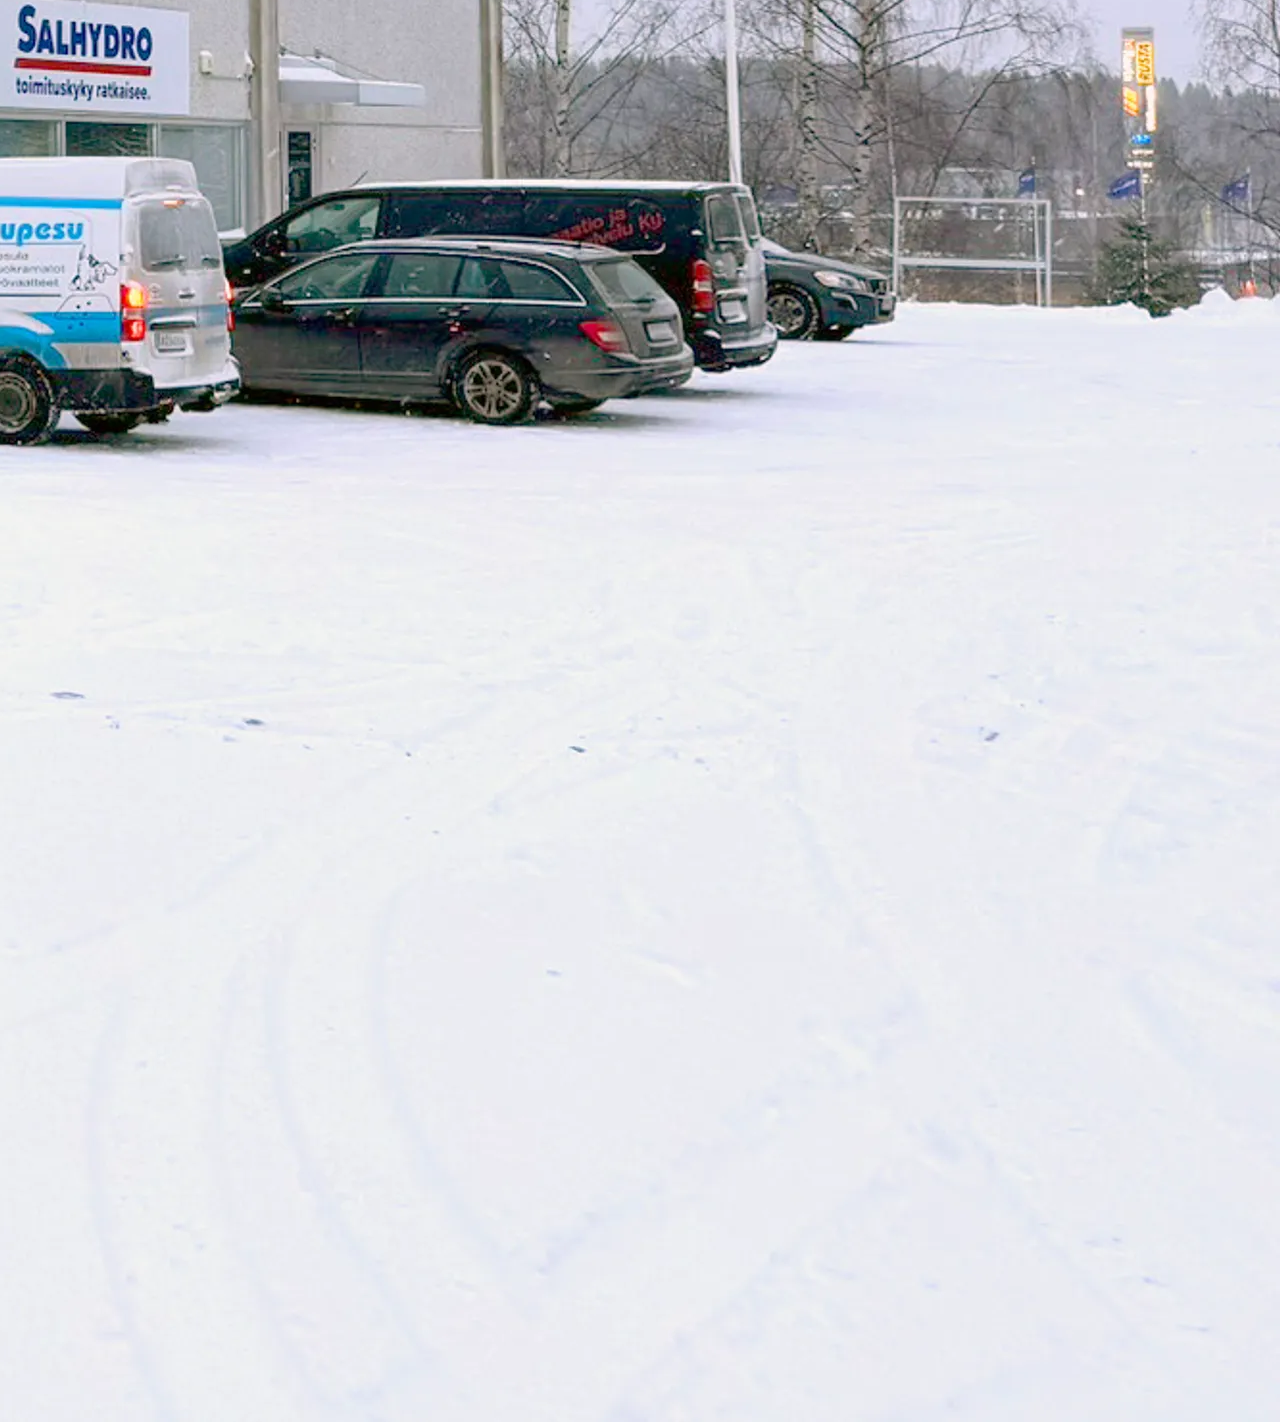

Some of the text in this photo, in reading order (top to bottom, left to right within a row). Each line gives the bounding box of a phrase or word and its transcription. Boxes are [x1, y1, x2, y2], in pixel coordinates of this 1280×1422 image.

[17, 4, 153, 62] SALHYDRO
[15, 75, 151, 101] toimituskyky ratkaisee.
